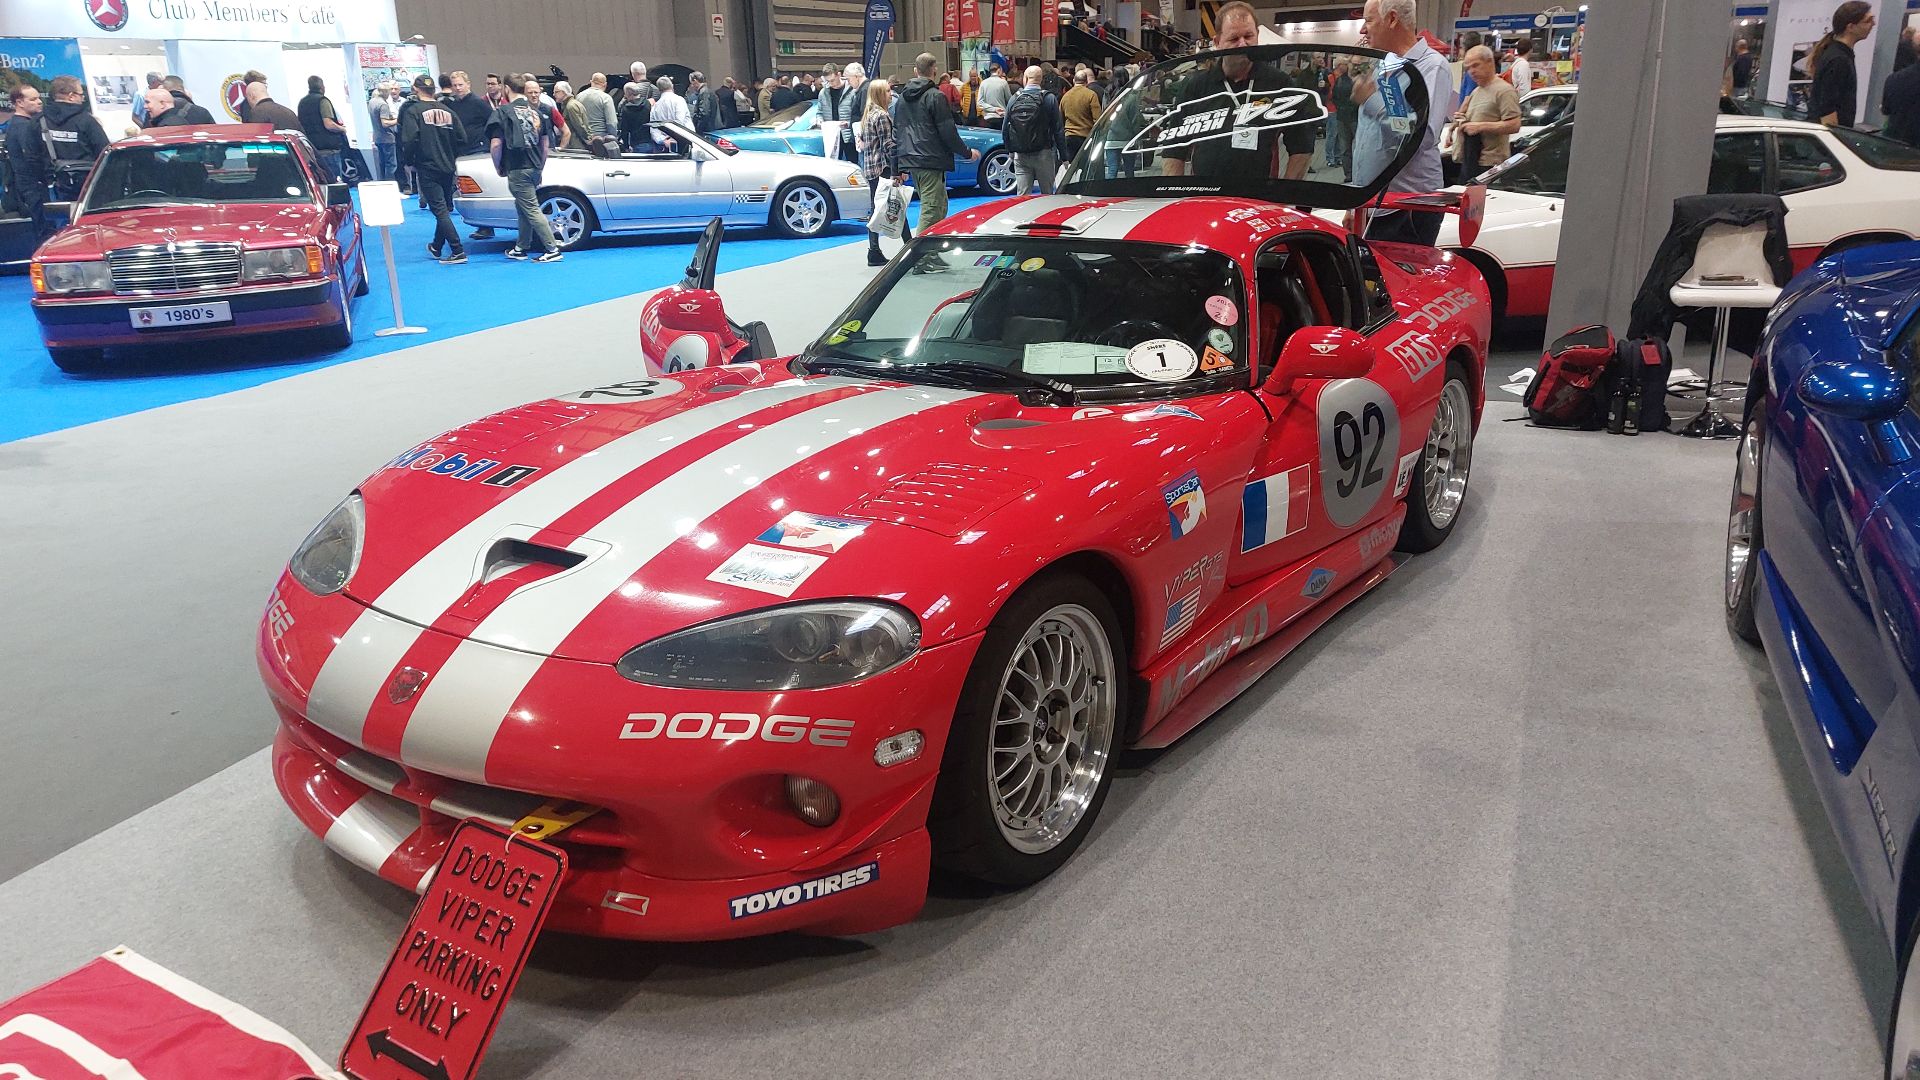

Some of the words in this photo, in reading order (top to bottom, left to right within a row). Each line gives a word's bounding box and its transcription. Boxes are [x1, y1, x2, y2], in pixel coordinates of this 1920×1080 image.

[149, 0, 195, 20] Club
[299, 5, 335, 25] Café
[1157, 117, 1226, 142] HEURES
[1211, 107, 1230, 120] DU
[1233, 94, 1308, 126] 24
[165, 308, 214, 322] 1980's
[1405, 287, 1478, 331] DODGE
[1156, 352, 1167, 367] 1
[1389, 332, 1442, 380] GTS
[390, 447, 501, 481] Mobil
[1333, 401, 1386, 499] 92
[1164, 555, 1208, 602] VIPER
[618, 713, 855, 748] DODGE
[452, 846, 544, 907] DODGE
[731, 883, 802, 918] TOYO
[803, 865, 871, 899] TIRES
[438, 889, 516, 951] VIPER
[404, 930, 502, 1001] PARKING
[396, 981, 471, 1041] ONLY
